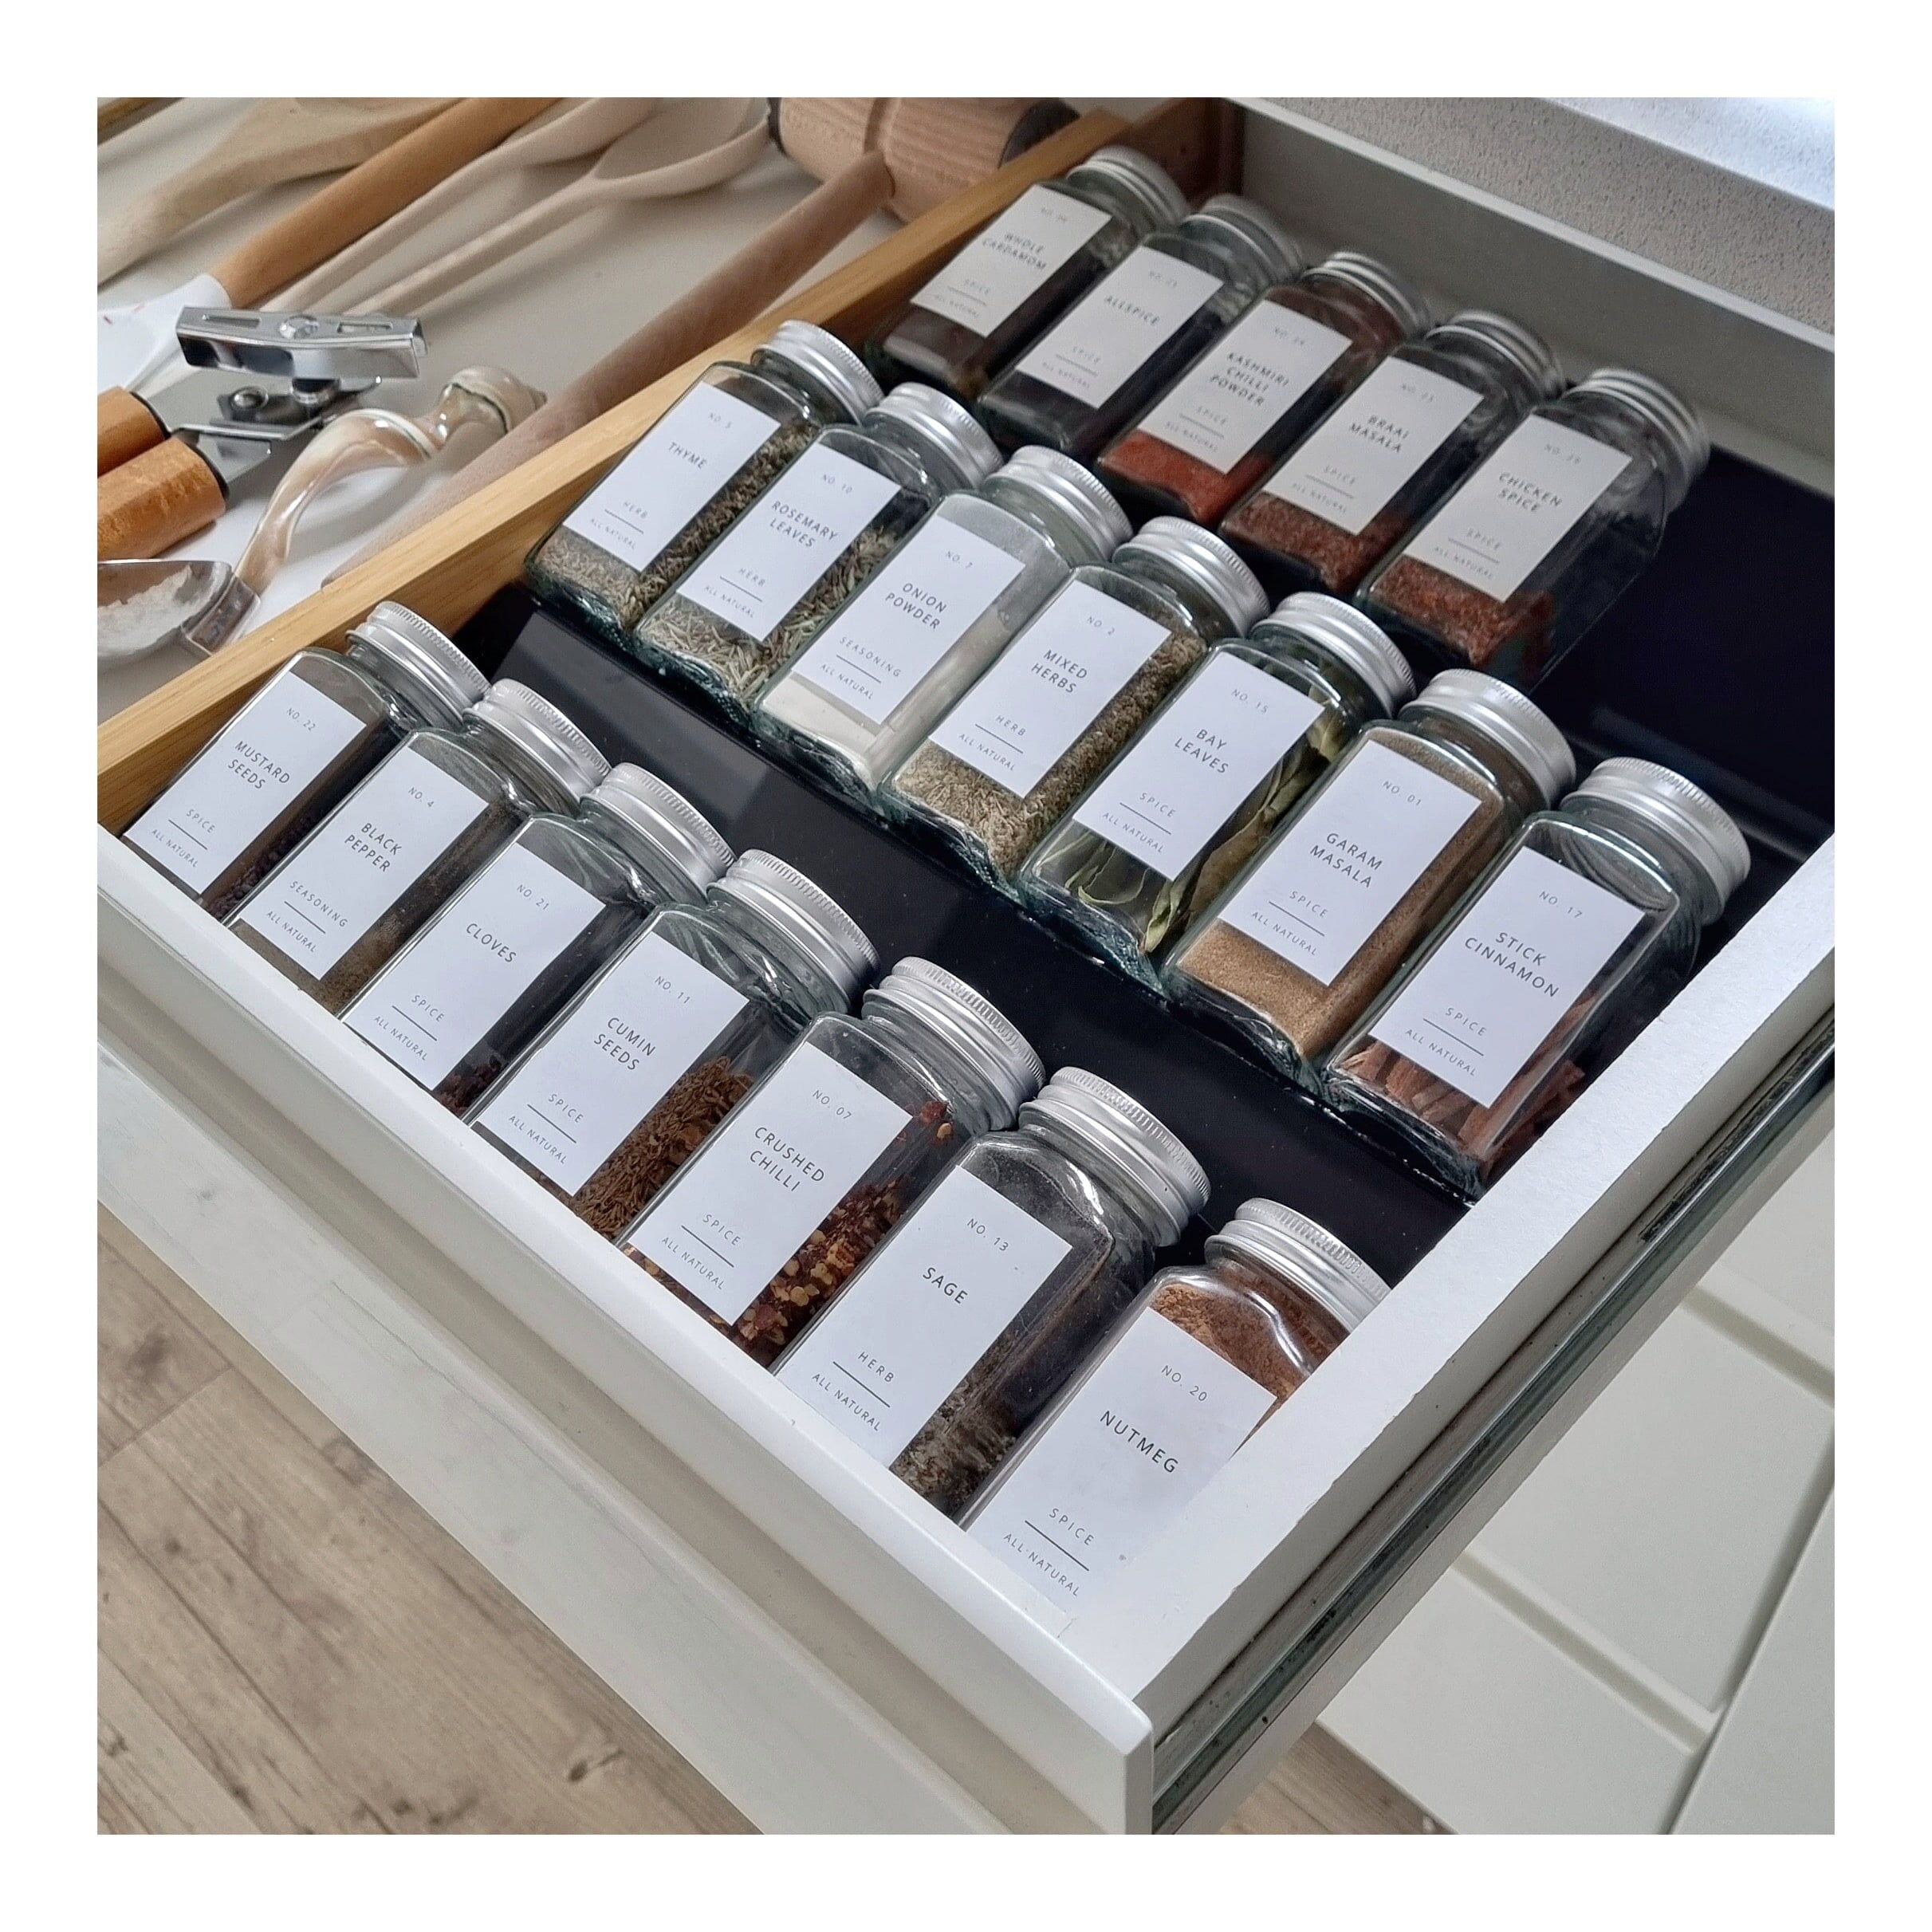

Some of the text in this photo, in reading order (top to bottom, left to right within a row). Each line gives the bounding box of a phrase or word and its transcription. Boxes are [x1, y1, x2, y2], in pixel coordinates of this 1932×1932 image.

[1106, 295, 1158, 325] ALLSPICE
[1210, 375, 1265, 406] POWDER
[1226, 367, 1269, 392] CHILLI
[1350, 423, 1401, 453] MASALA
[668, 442, 707, 469] THYME
[841, 483, 853, 494] 10
[1498, 489, 1540, 512] SPICE
[1499, 473, 1562, 507] CHICKEN
[623, 501, 648, 519] HERB
[771, 501, 838, 541] ROSEMARY
[590, 517, 635, 550] ALL NATURAL
[769, 517, 816, 547] LEAVES
[738, 568, 766, 587] HERB
[704, 585, 754, 618] ALL NATURAL
[885, 592, 940, 630] POWDER
[902, 583, 947, 613] ONION
[1087, 616, 1116, 636] NO. 2
[840, 636, 902, 677] SEASONING
[1043, 649, 1088, 679] MIXED
[821, 663, 873, 700] ALL NATURAL
[1031, 663, 1077, 693] HERBS
[1231, 688, 1269, 714] NO. 15
[288, 707, 316, 732] NO. 22
[995, 715, 1026, 736] HERB
[958, 734, 1015, 771] ALL NATURAL
[1175, 738, 1229, 773] LEAVES
[1196, 729, 1227, 750] BAY
[227, 759, 266, 789] SEEDS
[234, 741, 290, 784] MUSTARD
[407, 786, 424, 801] NO.
[1139, 792, 1176, 817] SPICE
[1383, 781, 1422, 806] NO. 01
[186, 809, 215, 833] SPICE
[1102, 812, 1163, 853] ALL NATURAL
[151, 828, 198, 868] ALL NATURAL
[344, 834, 391, 872] PEPPER
[360, 822, 402, 856] BLACK
[1326, 832, 1383, 870] GARAM
[1309, 844, 1371, 888] MASALA
[289, 880, 348, 927] SEASONING
[516, 883, 549, 911] NO. 21
[1289, 891, 1328, 918] SPICE
[1539, 891, 1583, 919] NO. 17
[266, 911, 317, 953] ALL NATURAL
[466, 923, 517, 962] CLOVES
[1251, 911, 1316, 956] ALL NATURAL
[1495, 932, 1546, 966] STICK
[1465, 937, 1559, 997] CINNAMON
[654, 975, 691, 1004] NO. 11
[411, 994, 445, 1022] SPICE
[1445, 1007, 1487, 1037] SPICE
[374, 1016, 427, 1061] ALL NATURAL
[593, 1033, 640, 1070] SEEDS
[608, 1017, 656, 1057] CUMIN
[1405, 1029, 1475, 1076] ALL NATURAL
[548, 1093, 584, 1123] SPICE
[812, 1089, 852, 1119] NO. 07
[509, 1116, 567, 1164] ALL NATURAL
[754, 1127, 824, 1182] CRUSHED
[750, 1150, 801, 1192] CHILLI
[702, 1214, 741, 1246] SPICE
[966, 1218, 1009, 1251] NO. 13
[661, 1237, 724, 1290] ALL NATURAL
[923, 1267, 968, 1304] SAGE
[857, 1352, 894, 1383] HERB
[1161, 1364, 1207, 1402] NO. 20
[812, 1373, 880, 1431] ALL NATURAL
[1100, 1410, 1178, 1474] NUTMEG
[1049, 1508, 1094, 1546] SPICE
[1003, 1533, 1080, 1597] ALL NATURAL
